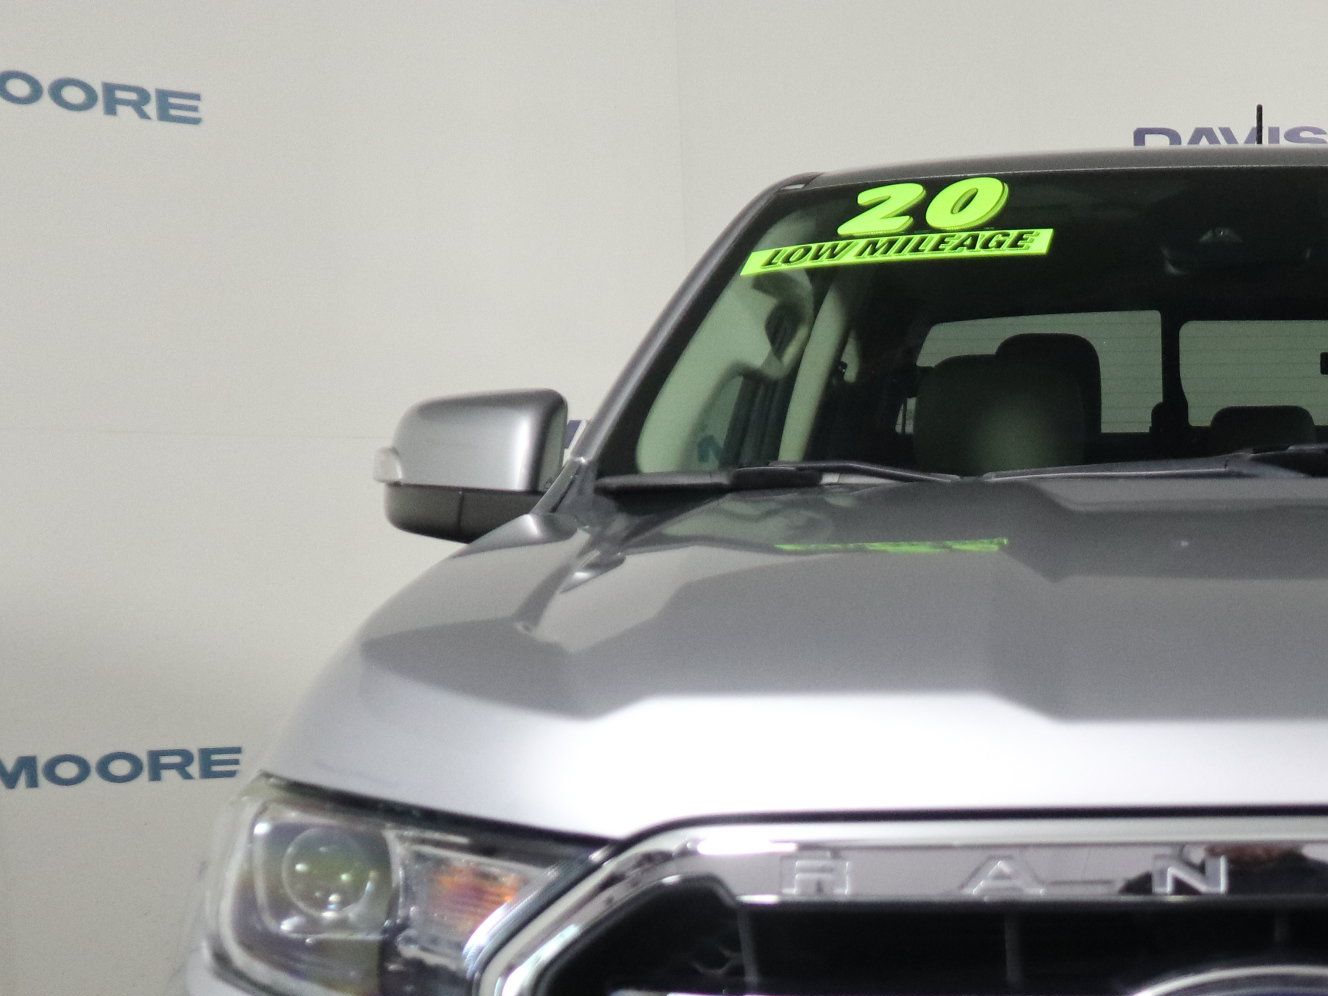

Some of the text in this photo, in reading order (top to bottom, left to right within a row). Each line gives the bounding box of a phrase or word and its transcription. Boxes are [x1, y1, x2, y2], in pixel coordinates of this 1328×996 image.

[838, 177, 1009, 236] 20
[761, 230, 1039, 268] LOW MILEAGE
[0, 746, 242, 790] MOORE
